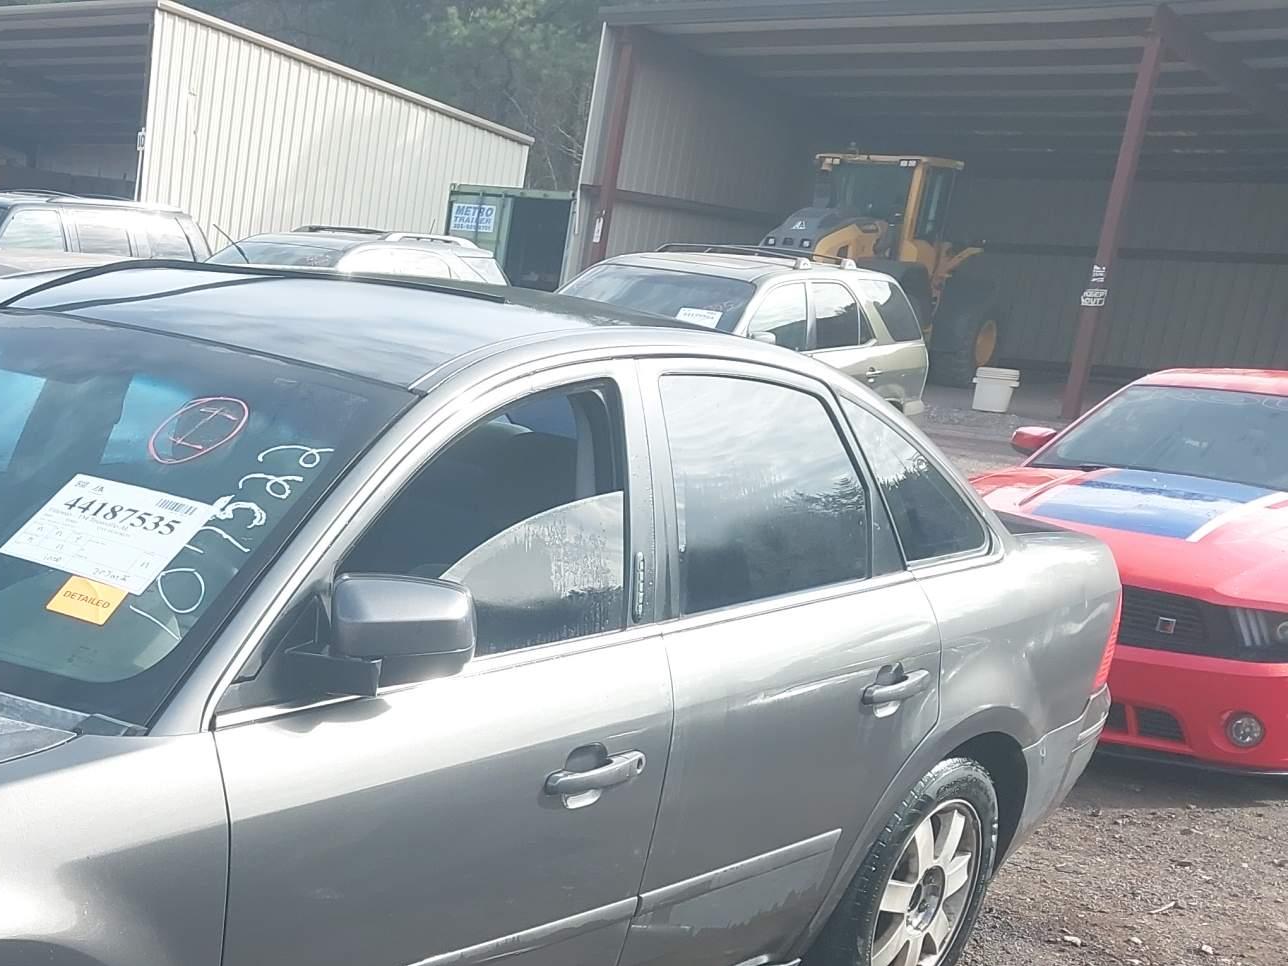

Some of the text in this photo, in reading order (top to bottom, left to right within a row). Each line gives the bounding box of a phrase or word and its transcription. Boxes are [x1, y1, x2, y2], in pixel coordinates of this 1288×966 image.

[455, 206, 494, 216] METRO
[64, 496, 181, 535] 44187535
[62, 589, 111, 610] DETAILED
